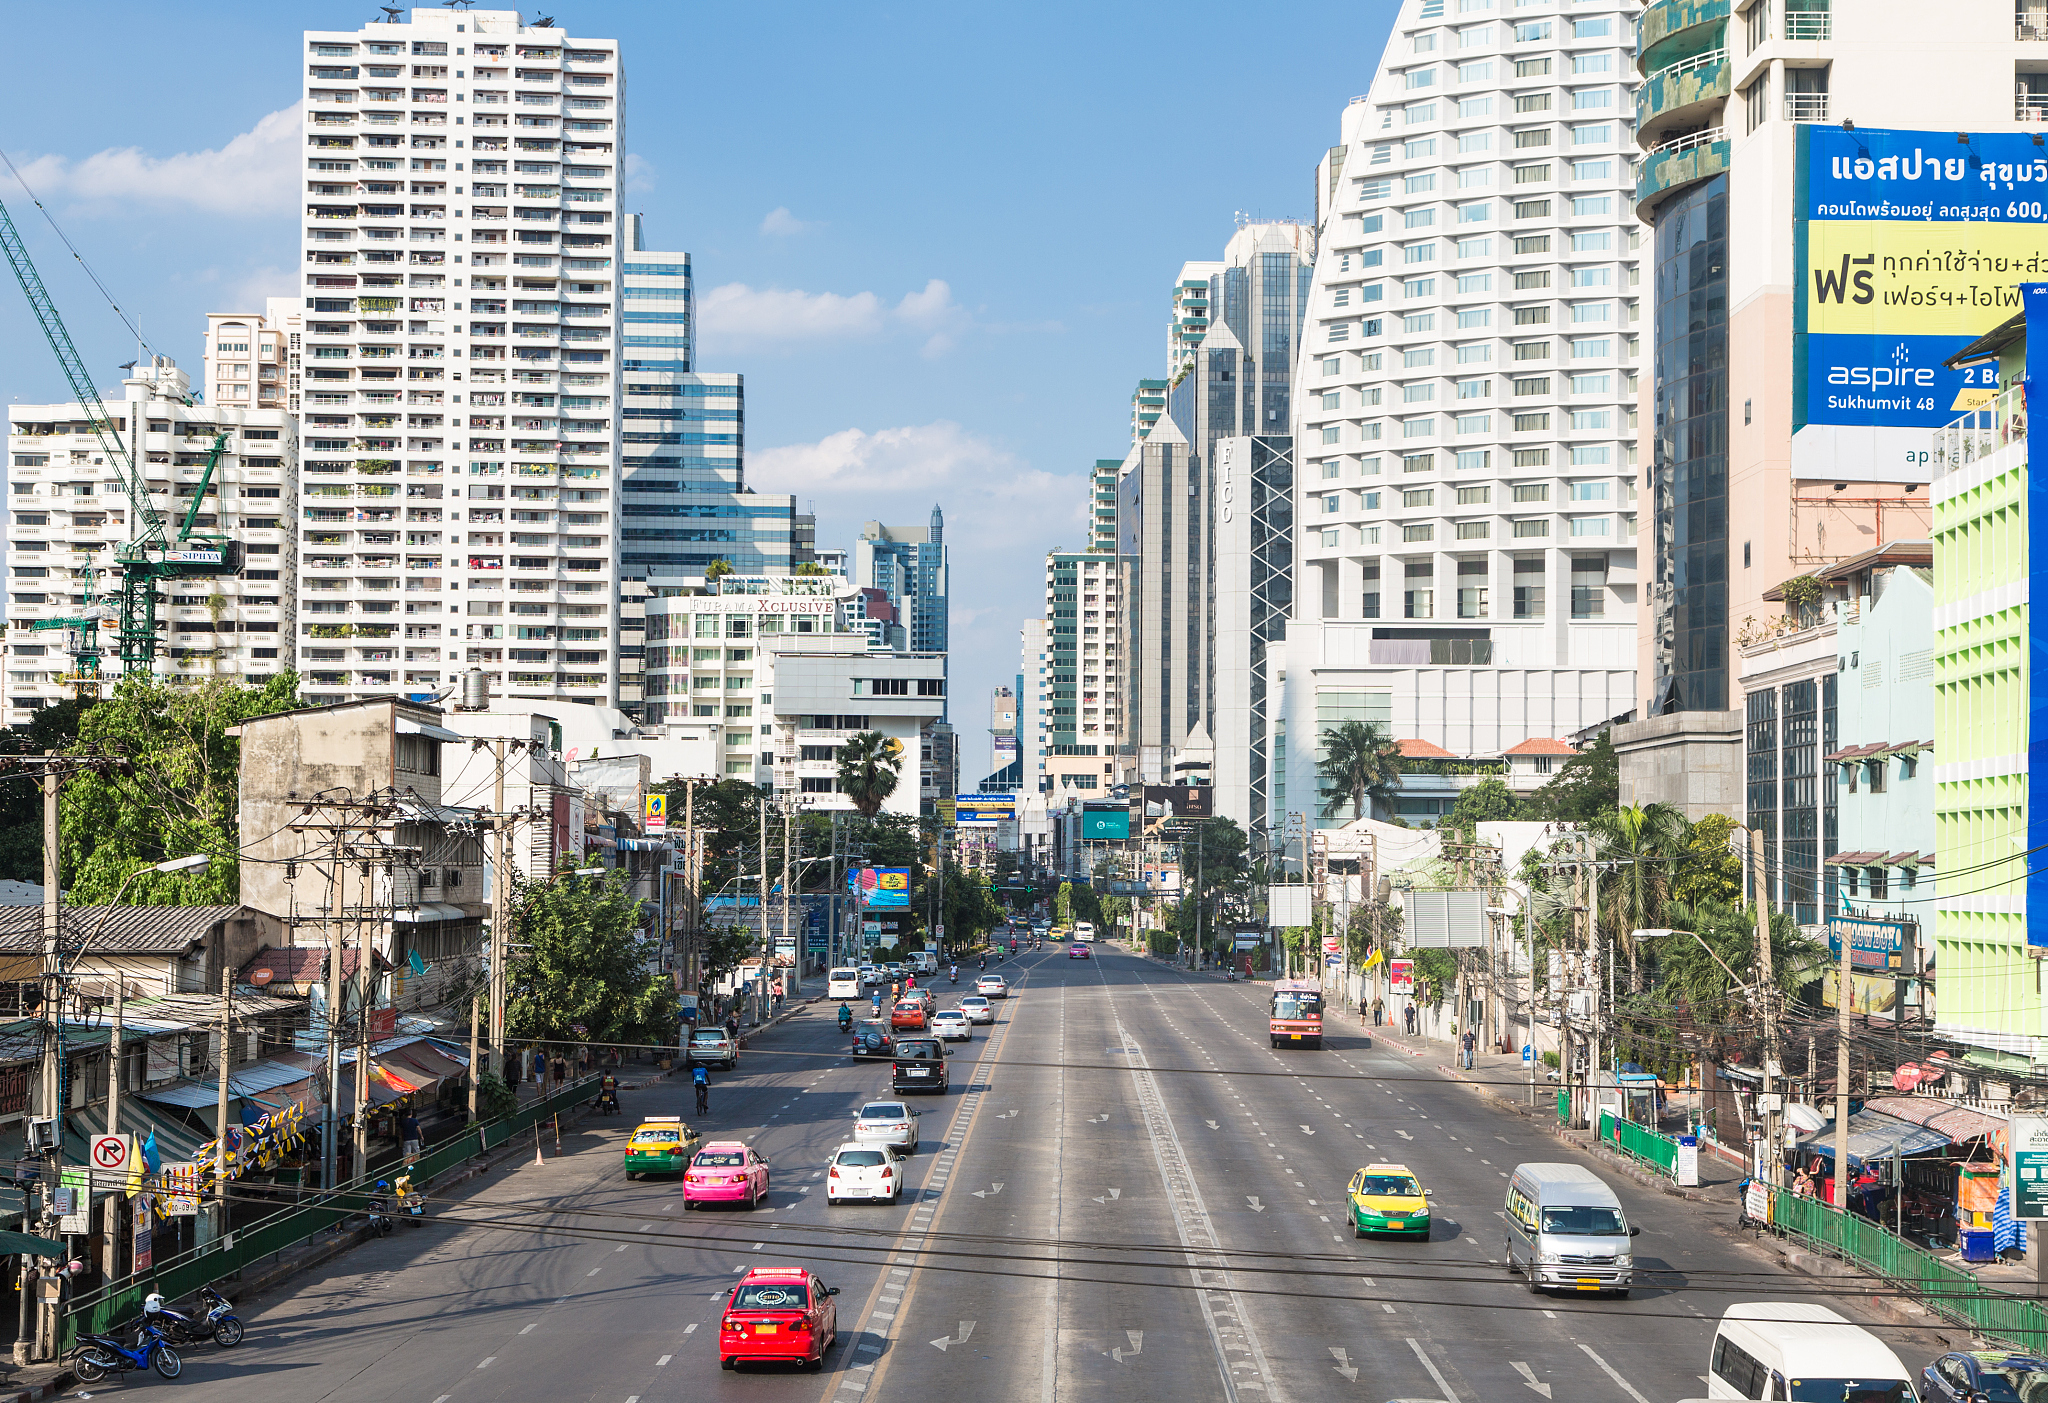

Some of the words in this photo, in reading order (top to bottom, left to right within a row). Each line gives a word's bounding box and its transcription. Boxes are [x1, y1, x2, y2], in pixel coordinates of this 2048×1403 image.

[1832, 148, 1965, 181] แอสปาย
[1817, 200, 1934, 221] คอนโดพร้อมอยู่
[1814, 254, 1875, 304] ฟรี
[1827, 362, 1935, 392] aspire
[1964, 369, 1975, 384] 2
[1828, 395, 1911, 410] Sukhumvit
[1916, 397, 1935, 411] 48
[1222, 447, 1234, 524] FICO
[182, 552, 220, 561] SIPHYA
[690, 599, 756, 612] FURAMA
[757, 599, 834, 613] XCLUSIVE
